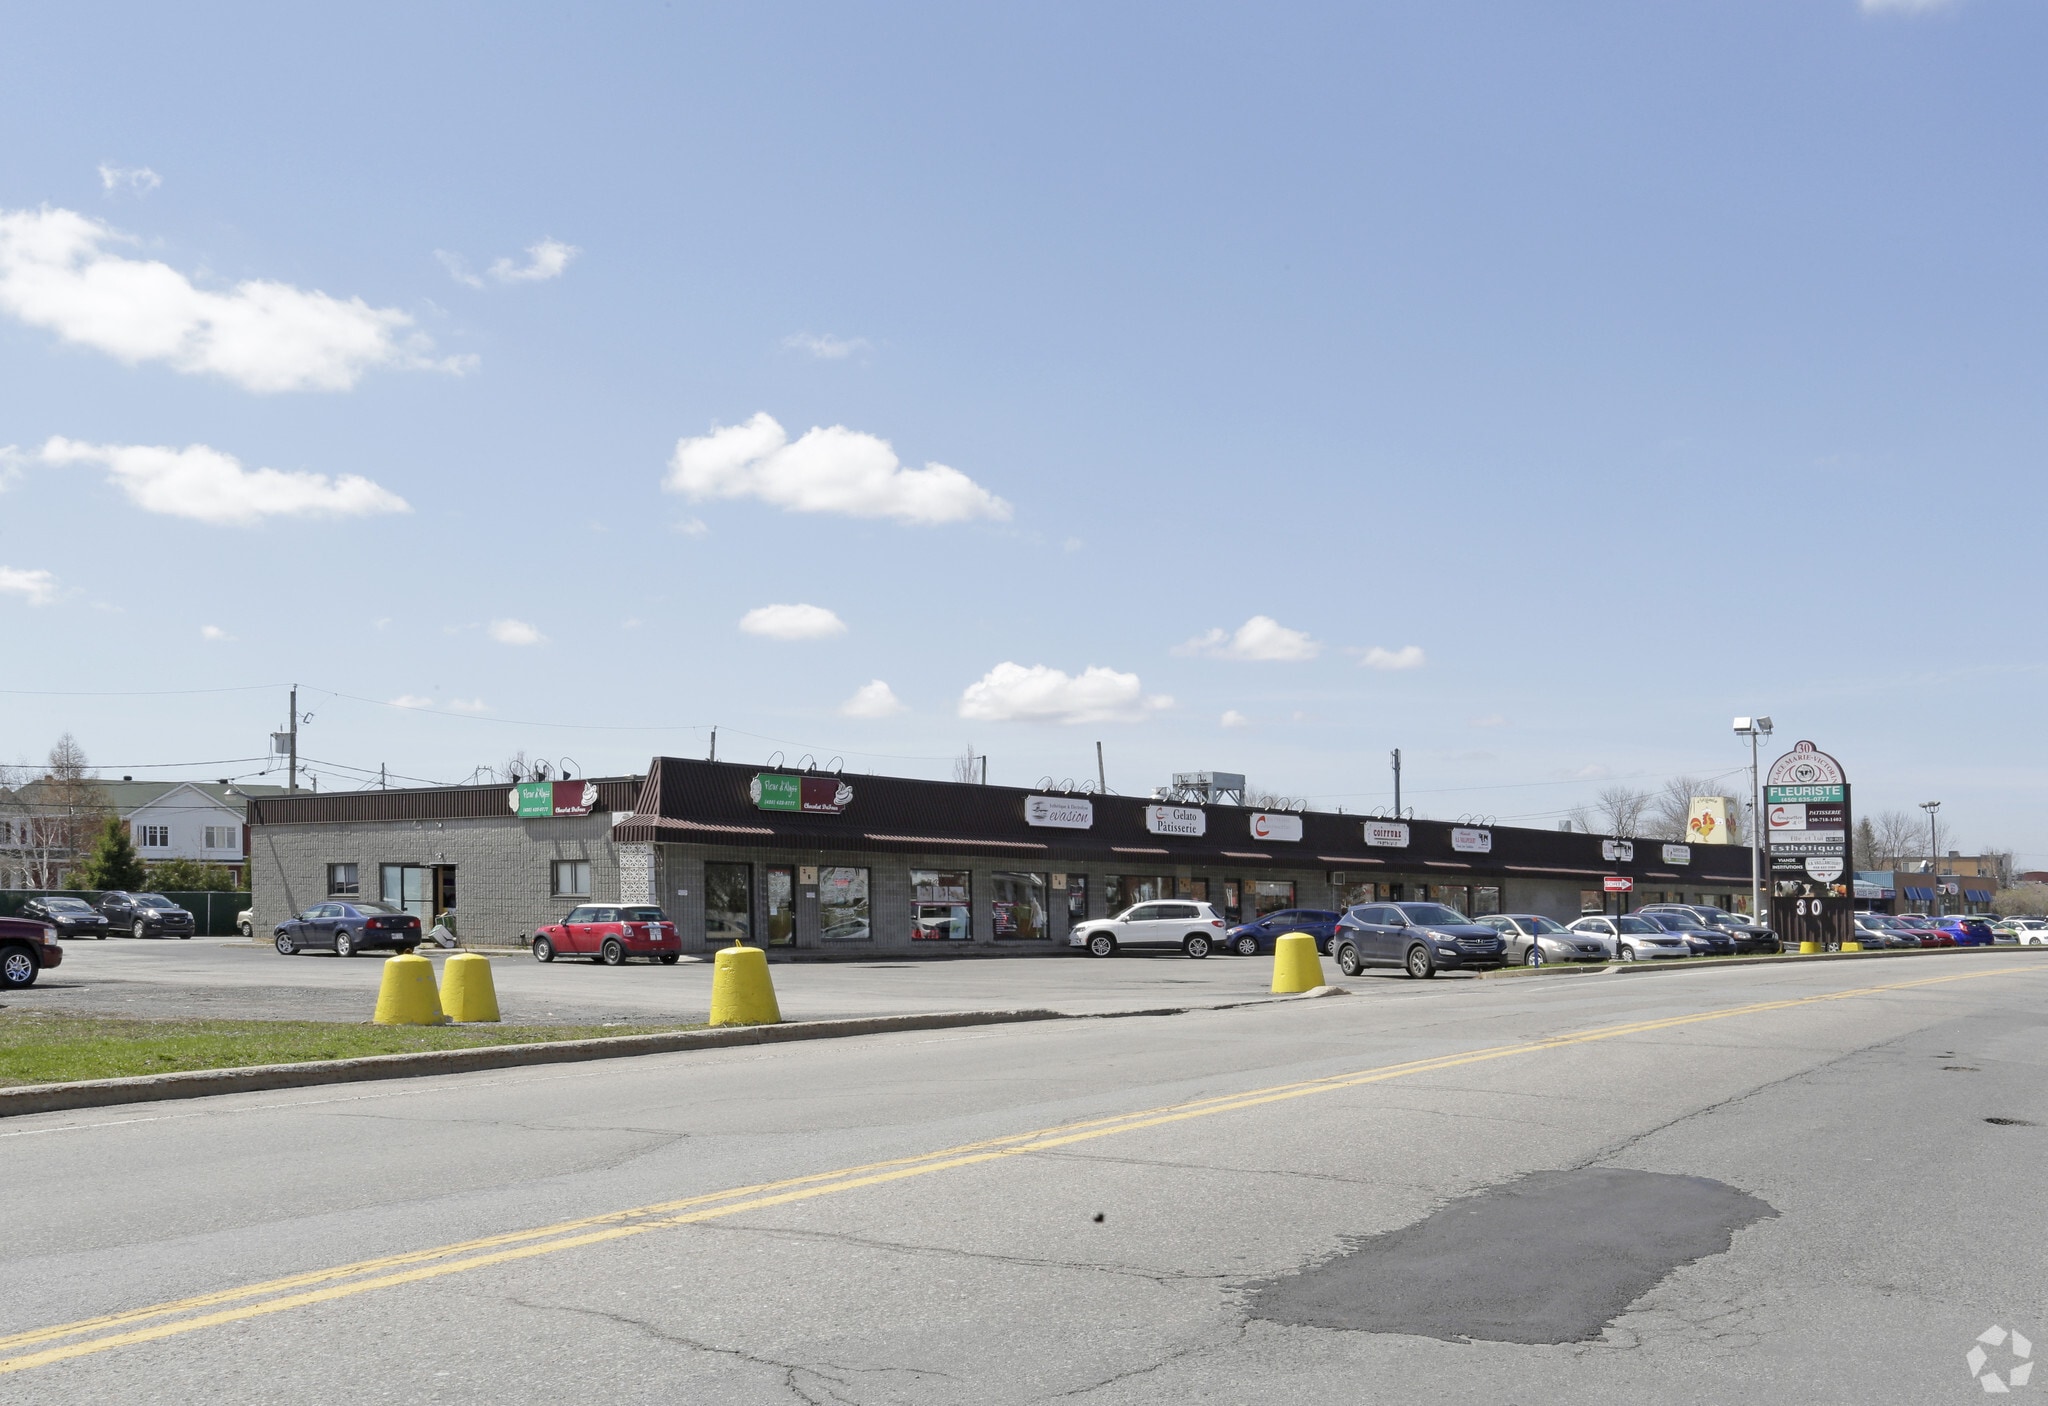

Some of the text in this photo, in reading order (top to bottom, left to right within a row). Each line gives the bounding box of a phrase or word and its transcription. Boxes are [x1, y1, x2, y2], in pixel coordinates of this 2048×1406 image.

[1798, 744, 1810, 753] 30
[1772, 754, 1837, 784] PLACE MARIE-VICTORIN
[1770, 786, 1840, 796] FLEURISTE
[1174, 809, 1196, 820] Gelato
[1158, 821, 1196, 833] Pâtisserie
